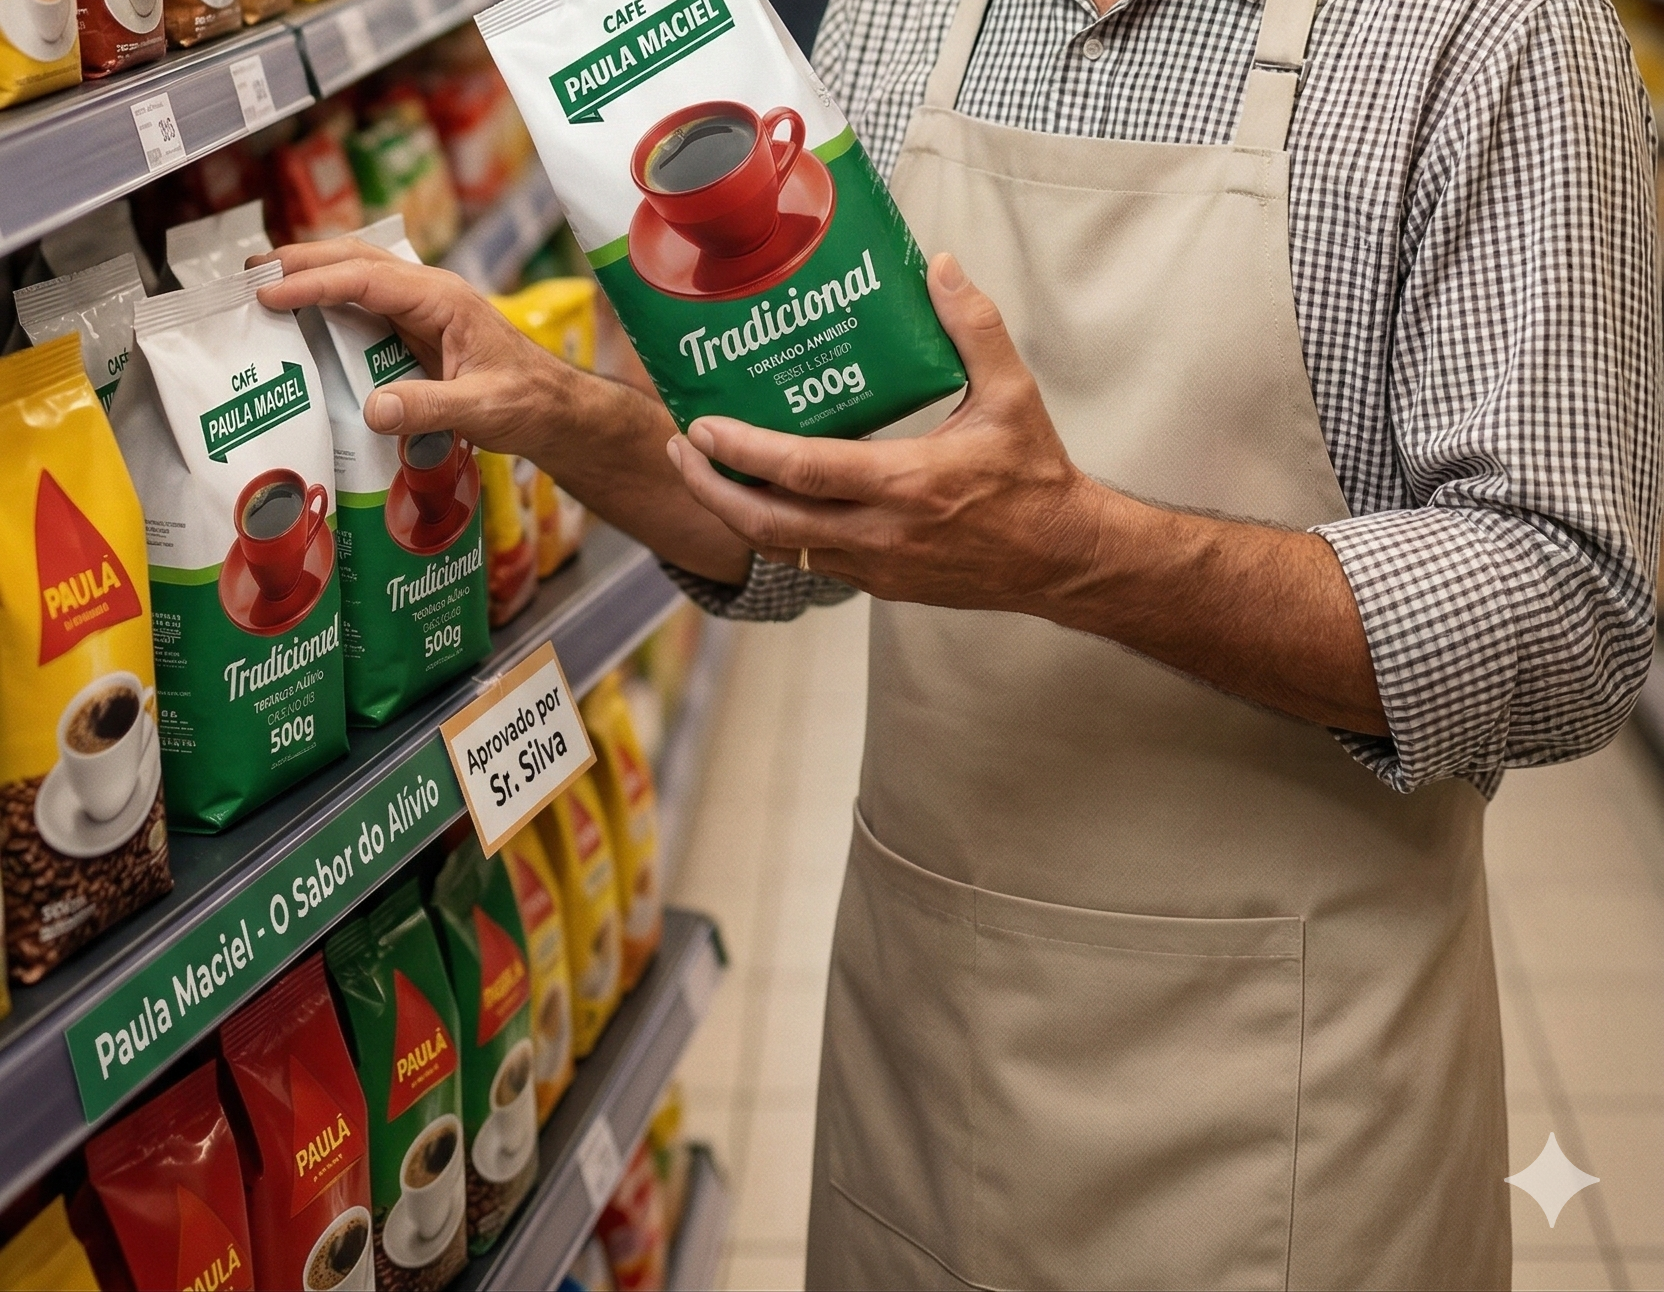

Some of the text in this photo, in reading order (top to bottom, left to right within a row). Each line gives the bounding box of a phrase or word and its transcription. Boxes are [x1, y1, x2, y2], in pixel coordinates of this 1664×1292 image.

[563, 45, 637, 103] PAULA
[679, 248, 881, 377] Tradicional
[231, 362, 258, 392] CAFÉ
[783, 362, 866, 414] 500g
[208, 377, 304, 443] PAULA MACIEL
[425, 624, 461, 658] 500g
[271, 714, 314, 754] 500g
[466, 686, 560, 776] Aprovado por
[490, 731, 567, 807] Sr. Silva
[95, 996, 172, 1081] Paula
[172, 919, 254, 1017] Maciel
[270, 893, 289, 935] O
[292, 844, 353, 918] Sabor
[358, 821, 385, 864] do
[387, 774, 439, 843] Alívio
